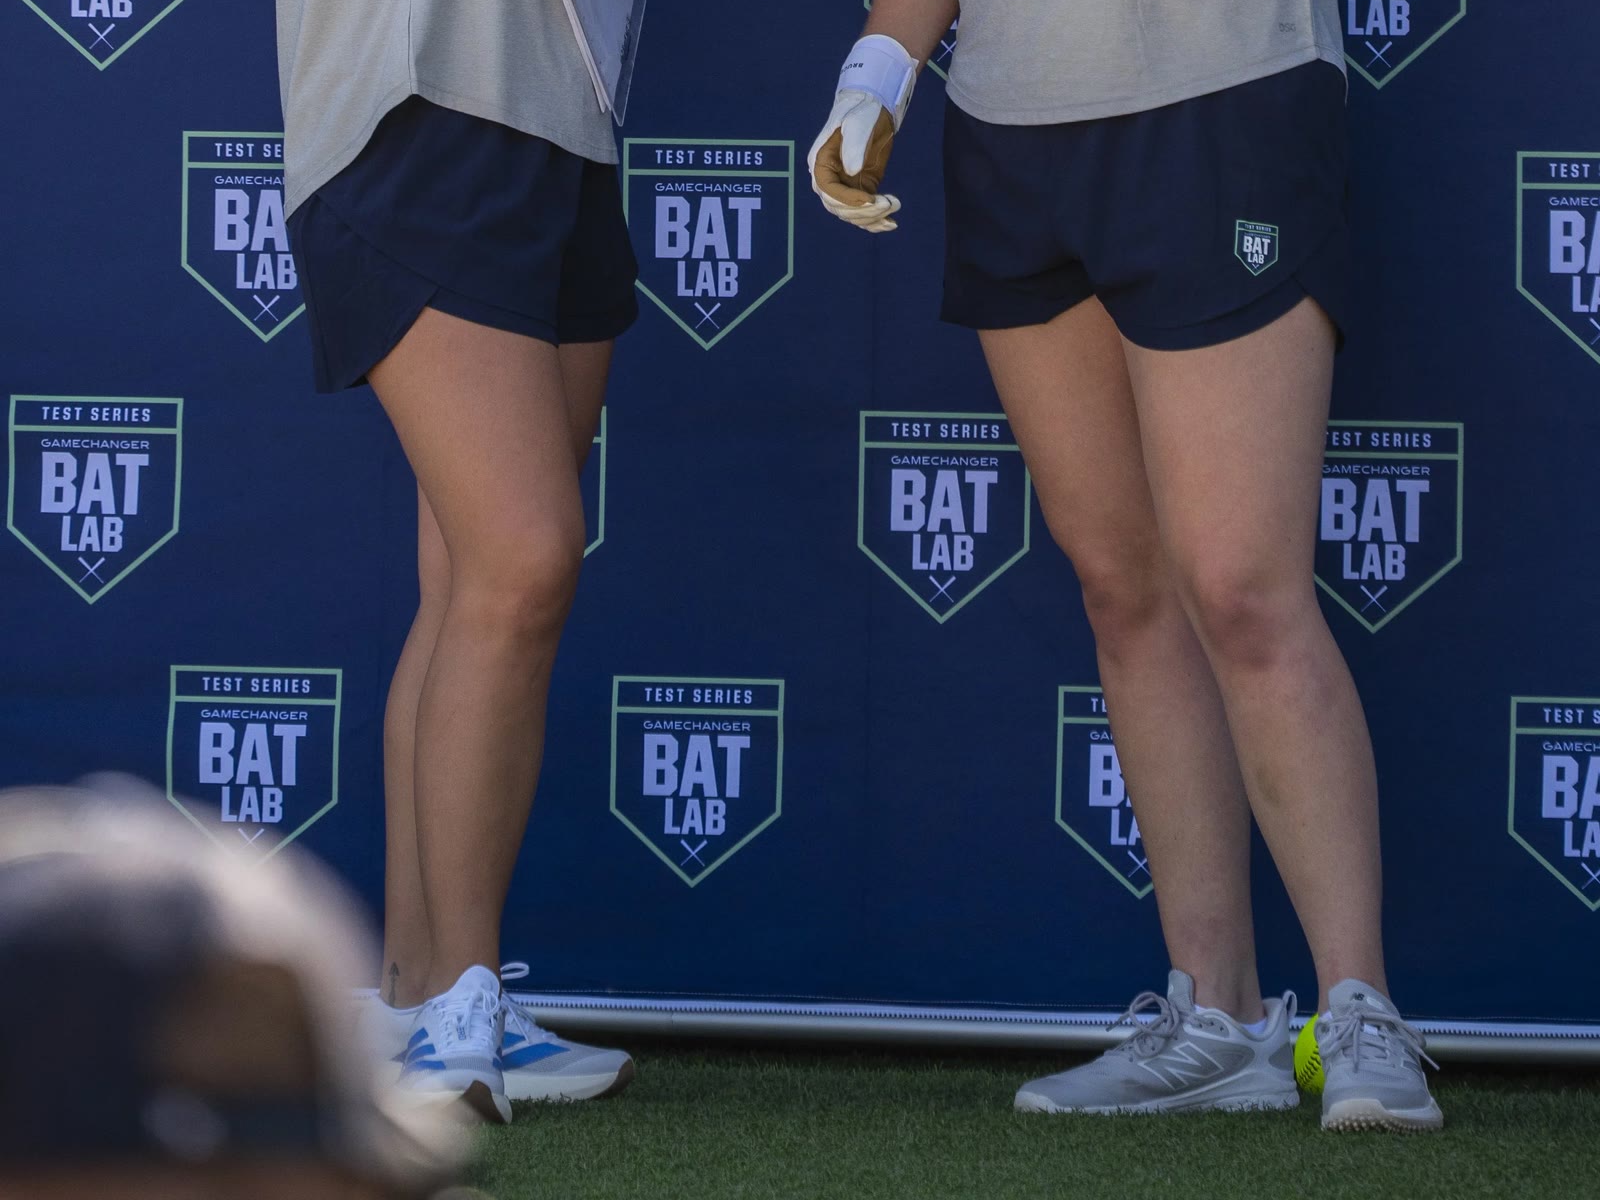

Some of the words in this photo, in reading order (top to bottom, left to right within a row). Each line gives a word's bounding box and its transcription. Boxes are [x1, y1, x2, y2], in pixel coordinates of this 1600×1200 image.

[1348, 0, 1410, 35] LAB
[215, 143, 254, 157] TEST
[656, 150, 694, 164] TEST
[704, 151, 762, 165] SERIES
[214, 176, 284, 185] GAMECHA
[1550, 164, 1590, 178] TEST
[655, 183, 761, 192] GAMECHANGER
[214, 189, 290, 252] BA
[656, 196, 761, 259] BAT
[1243, 235, 1270, 256] BAT
[1247, 252, 1264, 265] LAB
[236, 254, 296, 289] LAB
[678, 261, 738, 297] LAB
[42, 407, 82, 420] TEST
[91, 408, 150, 422] SERIES
[892, 423, 931, 437] TEST
[940, 424, 999, 438] SERIES
[1326, 432, 1362, 446] EST
[1372, 433, 1431, 447] SERIES
[41, 439, 149, 449] GAMECHANGER
[891, 456, 998, 466] GAMECHANGER
[41, 452, 148, 514] BAT
[891, 469, 998, 533] BAT
[1320, 478, 1430, 542] BAT
[61, 516, 123, 552] LAB
[912, 534, 974, 570] LAB
[1344, 544, 1405, 580] LAB
[202, 677, 242, 691] TEST
[251, 678, 310, 693] SERIES
[645, 688, 684, 702] TEST
[693, 689, 752, 704] SERIES
[201, 710, 308, 720] GAMECHANGER
[644, 720, 750, 731] GAMECHANGER
[1544, 708, 1584, 723] TEST
[200, 722, 306, 785] BAT
[1543, 742, 1600, 752] GAMECH
[643, 734, 750, 797] BAT
[1542, 755, 1600, 818] BA
[221, 786, 283, 822] LAB
[664, 798, 726, 835] LAB
[1564, 821, 1600, 857] LA
